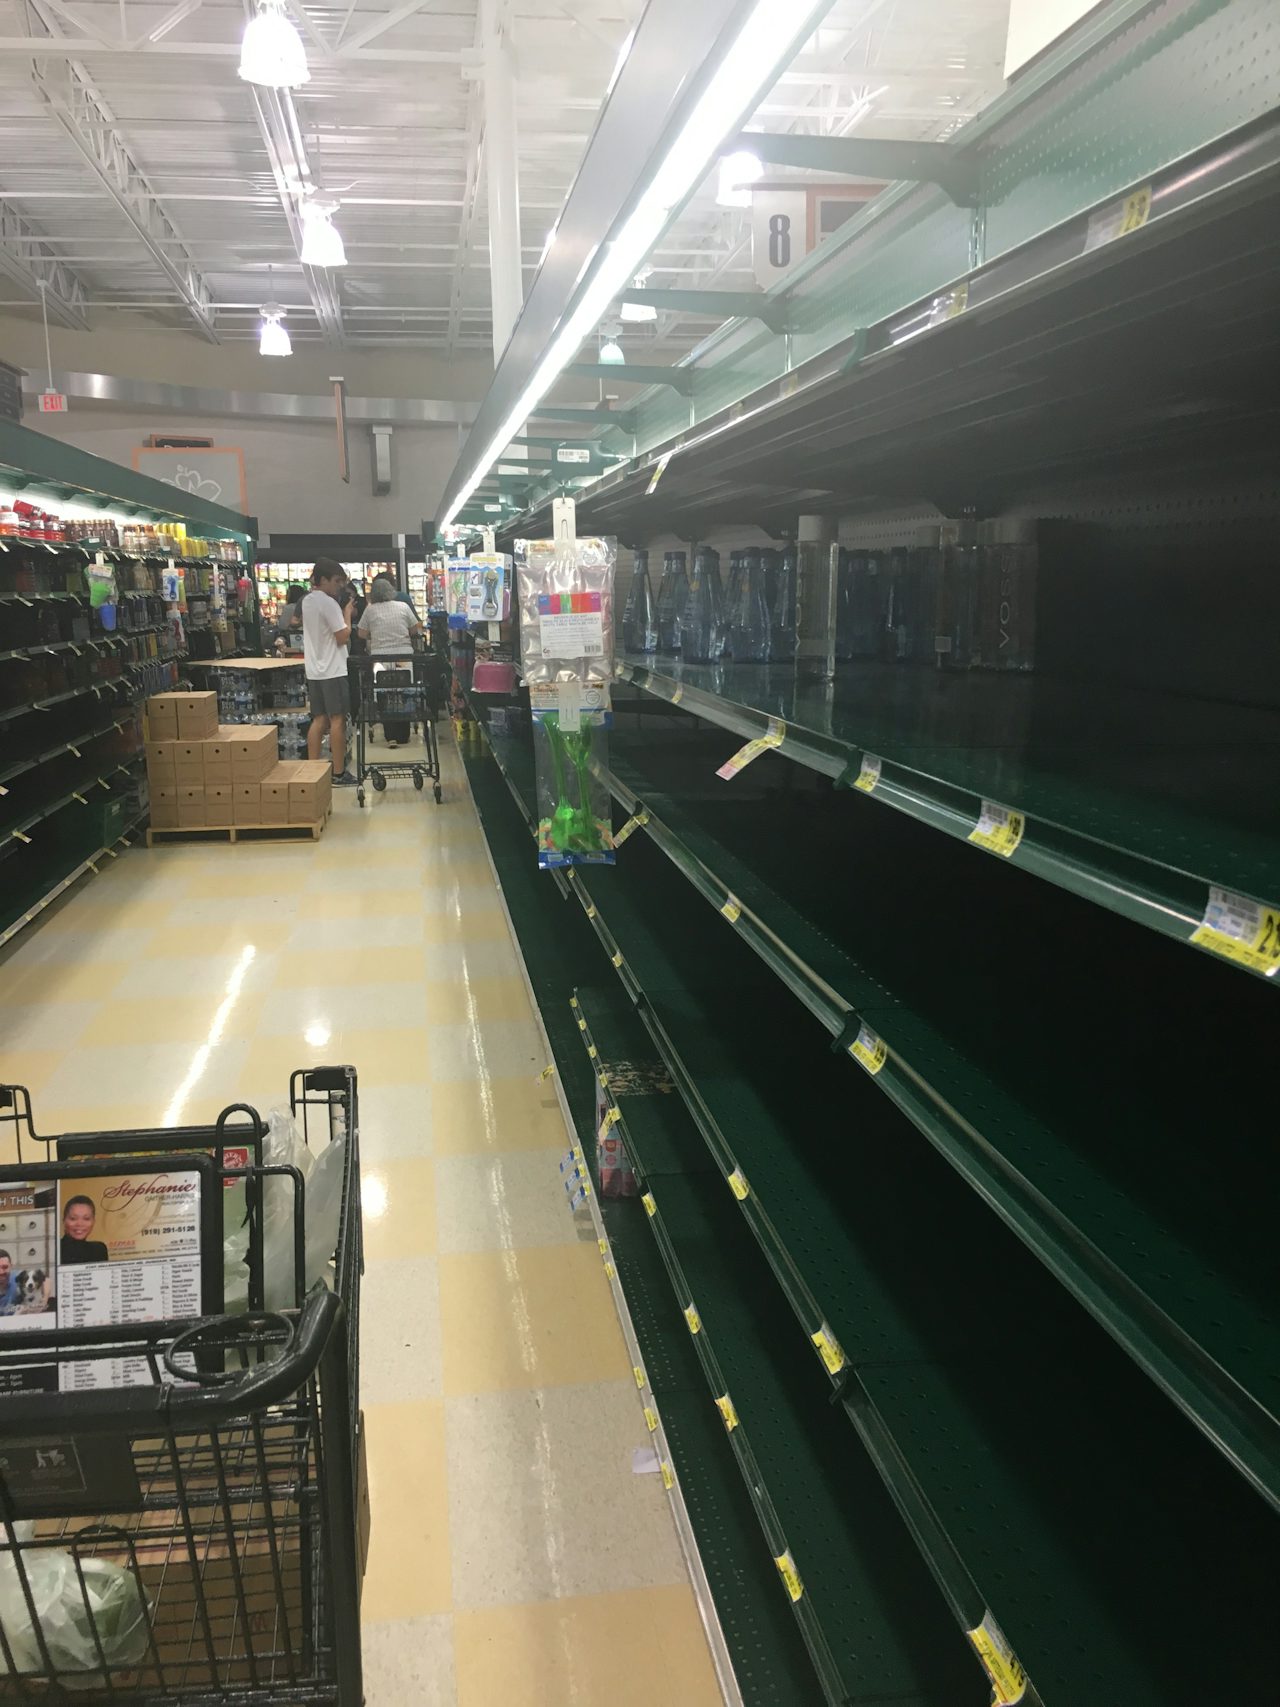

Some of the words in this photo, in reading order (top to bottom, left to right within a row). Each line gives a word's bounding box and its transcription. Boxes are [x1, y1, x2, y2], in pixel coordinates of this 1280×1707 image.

[769, 214, 791, 267] 8
[43, 395, 63, 410] EXIT
[999, 551, 1010, 648] VOSS
[10, 1195, 34, 1206] THIS
[101, 1174, 197, 1212] Stephanie
